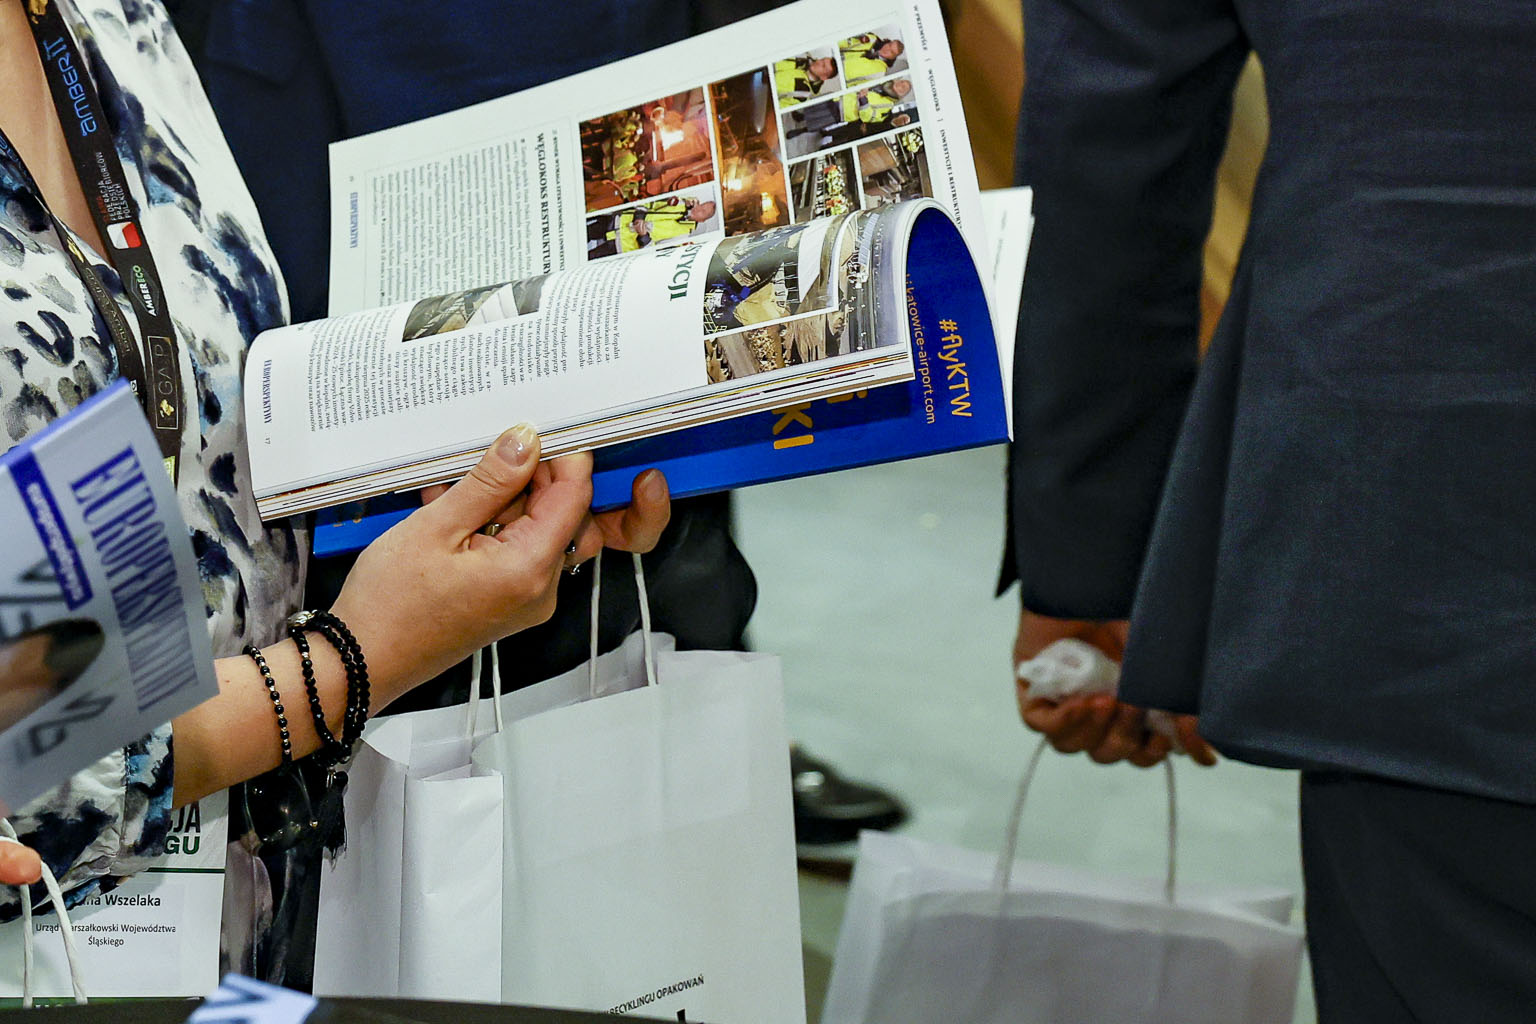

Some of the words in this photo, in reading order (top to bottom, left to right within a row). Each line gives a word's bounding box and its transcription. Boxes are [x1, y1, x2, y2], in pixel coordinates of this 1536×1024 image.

[939, 129, 952, 171] INWESTYCJE
[535, 133, 548, 200] WĘGLOKOKS
[96, 180, 117, 220] FEDERACJA
[113, 183, 130, 218] POLSKICH
[133, 264, 157, 317] AMBERECO
[604, 307, 613, 346] kruszarkami
[450, 338, 458, 375] mobilnego
[459, 336, 467, 354] nych,
[484, 336, 492, 368] Obecnie,
[560, 325, 568, 359] wydajność
[586, 334, 595, 366] produkcji
[612, 333, 620, 360] Kopalni
[559, 359, 567, 374] pro-
[578, 348, 586, 370] obsłu-
[937, 319, 973, 417] #flyKTW
[330, 374, 338, 400] nowych
[419, 375, 427, 406] zwiększy
[434, 362, 442, 391] napędzie
[501, 365, 509, 386] spalin
[262, 359, 273, 425] EUROPERSPEKTYWY
[370, 382, 379, 417] inwestycji
[378, 387, 386, 415] procesie
[395, 397, 403, 413] pali-
[410, 382, 419, 409] produk-
[105, 893, 161, 907] Wszelaka
[35, 923, 60, 934] Urząd
[61, 923, 119, 933] arszałkowski
[120, 923, 176, 934] Województwa
[88, 936, 125, 947] Śląskiego
[655, 973, 705, 1001] OPAKOWAŃ
